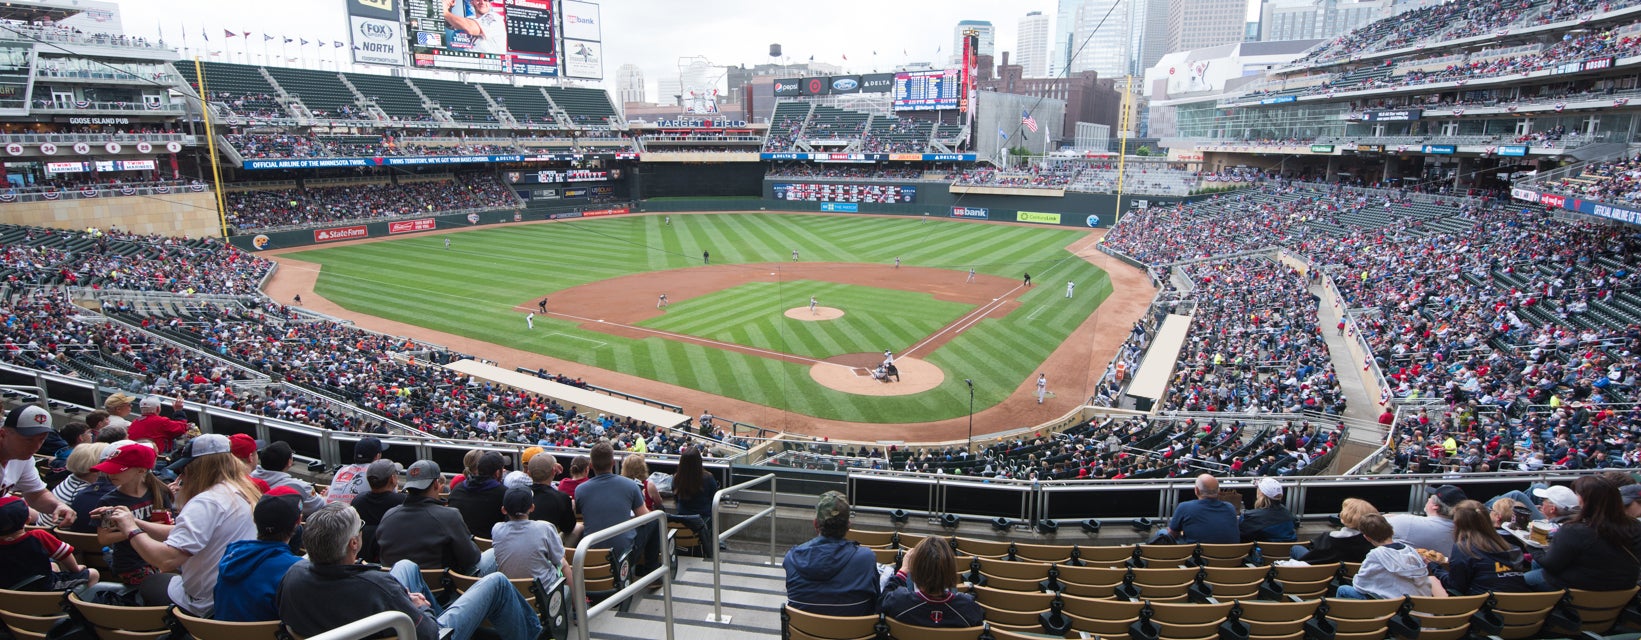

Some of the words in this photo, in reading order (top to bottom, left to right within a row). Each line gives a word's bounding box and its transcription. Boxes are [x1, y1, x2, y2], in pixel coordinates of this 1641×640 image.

[366, 23, 386, 34] FOX
[362, 41, 394, 54] NORTH
[782, 83, 798, 92] pepsi
[837, 79, 855, 90] Ford
[69, 117, 91, 125] GOOSE
[91, 117, 115, 125] ISLAND
[953, 207, 987, 217] usbank
[1593, 204, 1611, 218] OFFICIAL
[1611, 207, 1630, 221] AIRLINE
[1629, 210, 1637, 223] OF
[1029, 213, 1057, 222] CenturyLink
